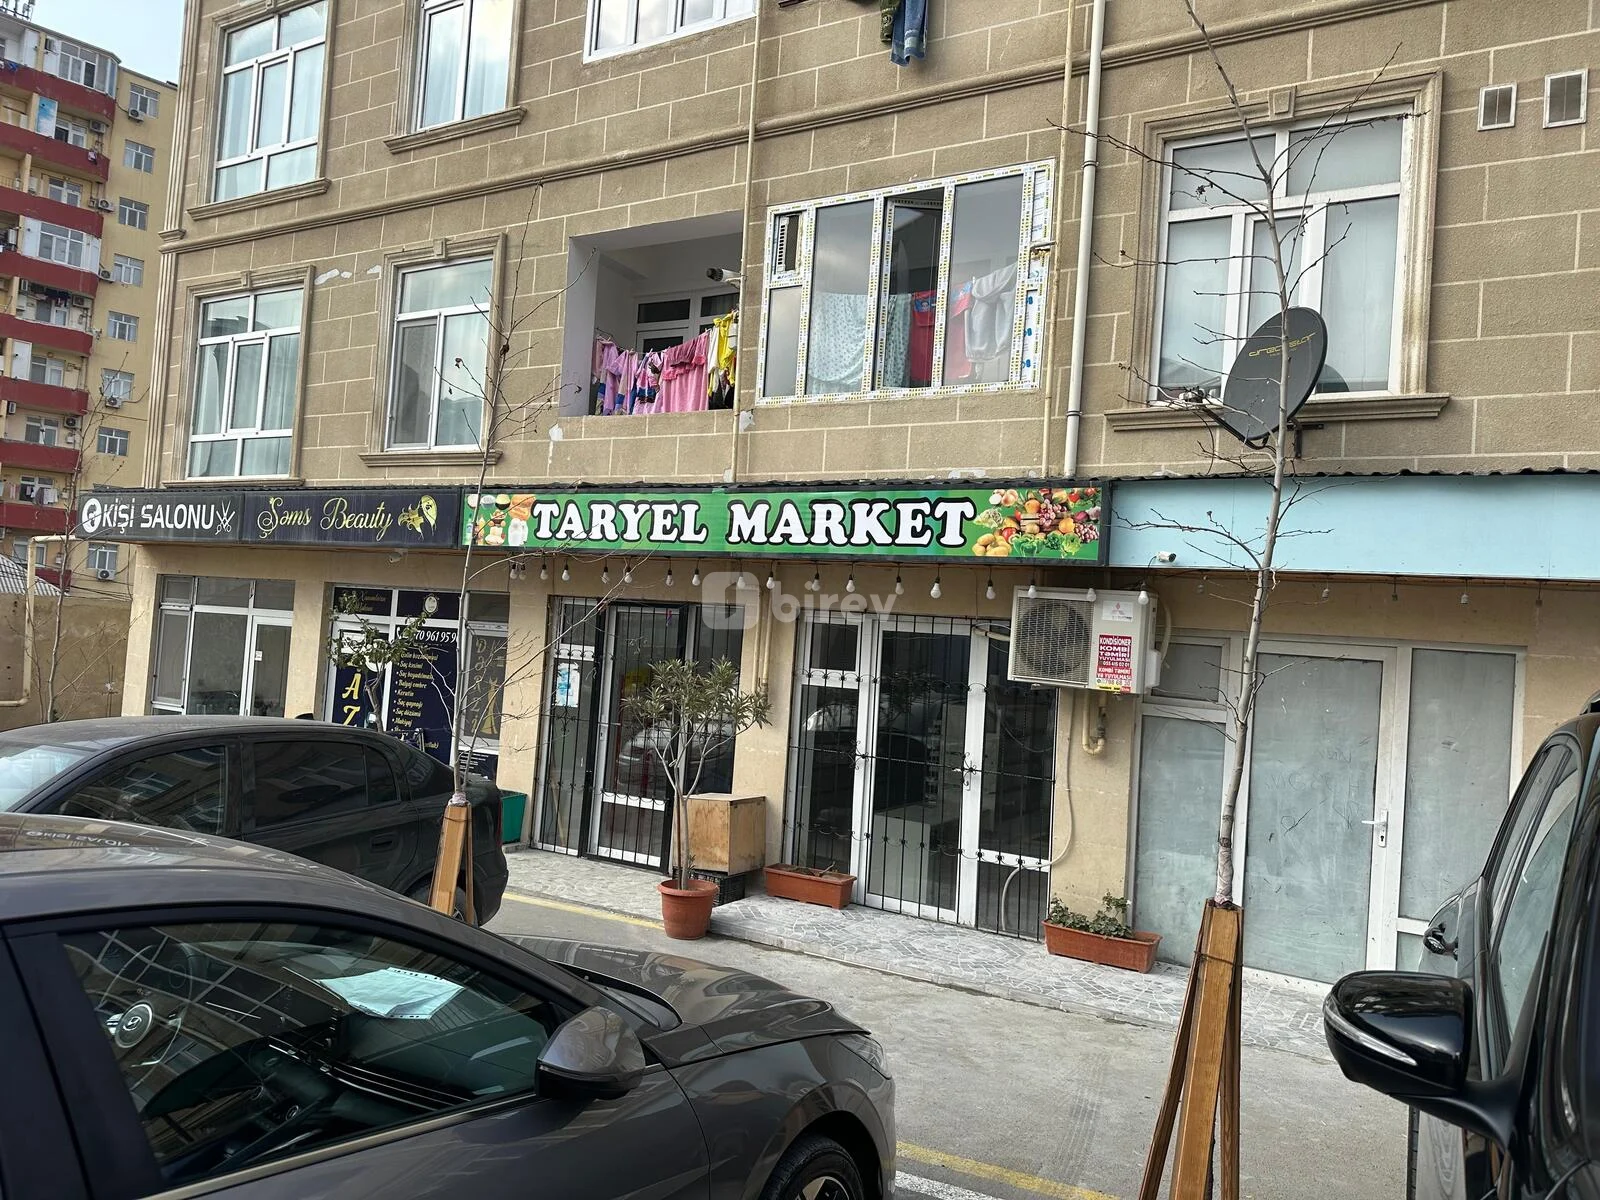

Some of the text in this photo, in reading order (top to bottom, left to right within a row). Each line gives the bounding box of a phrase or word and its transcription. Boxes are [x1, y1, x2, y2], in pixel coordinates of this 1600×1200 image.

[102, 498, 215, 534] KİŞİ SALONU
[257, 496, 393, 541] Şəms Beauty
[533, 499, 976, 547] TARYEL MARKET
[426, 630, 439, 641] 961
[440, 631, 451, 643] 95
